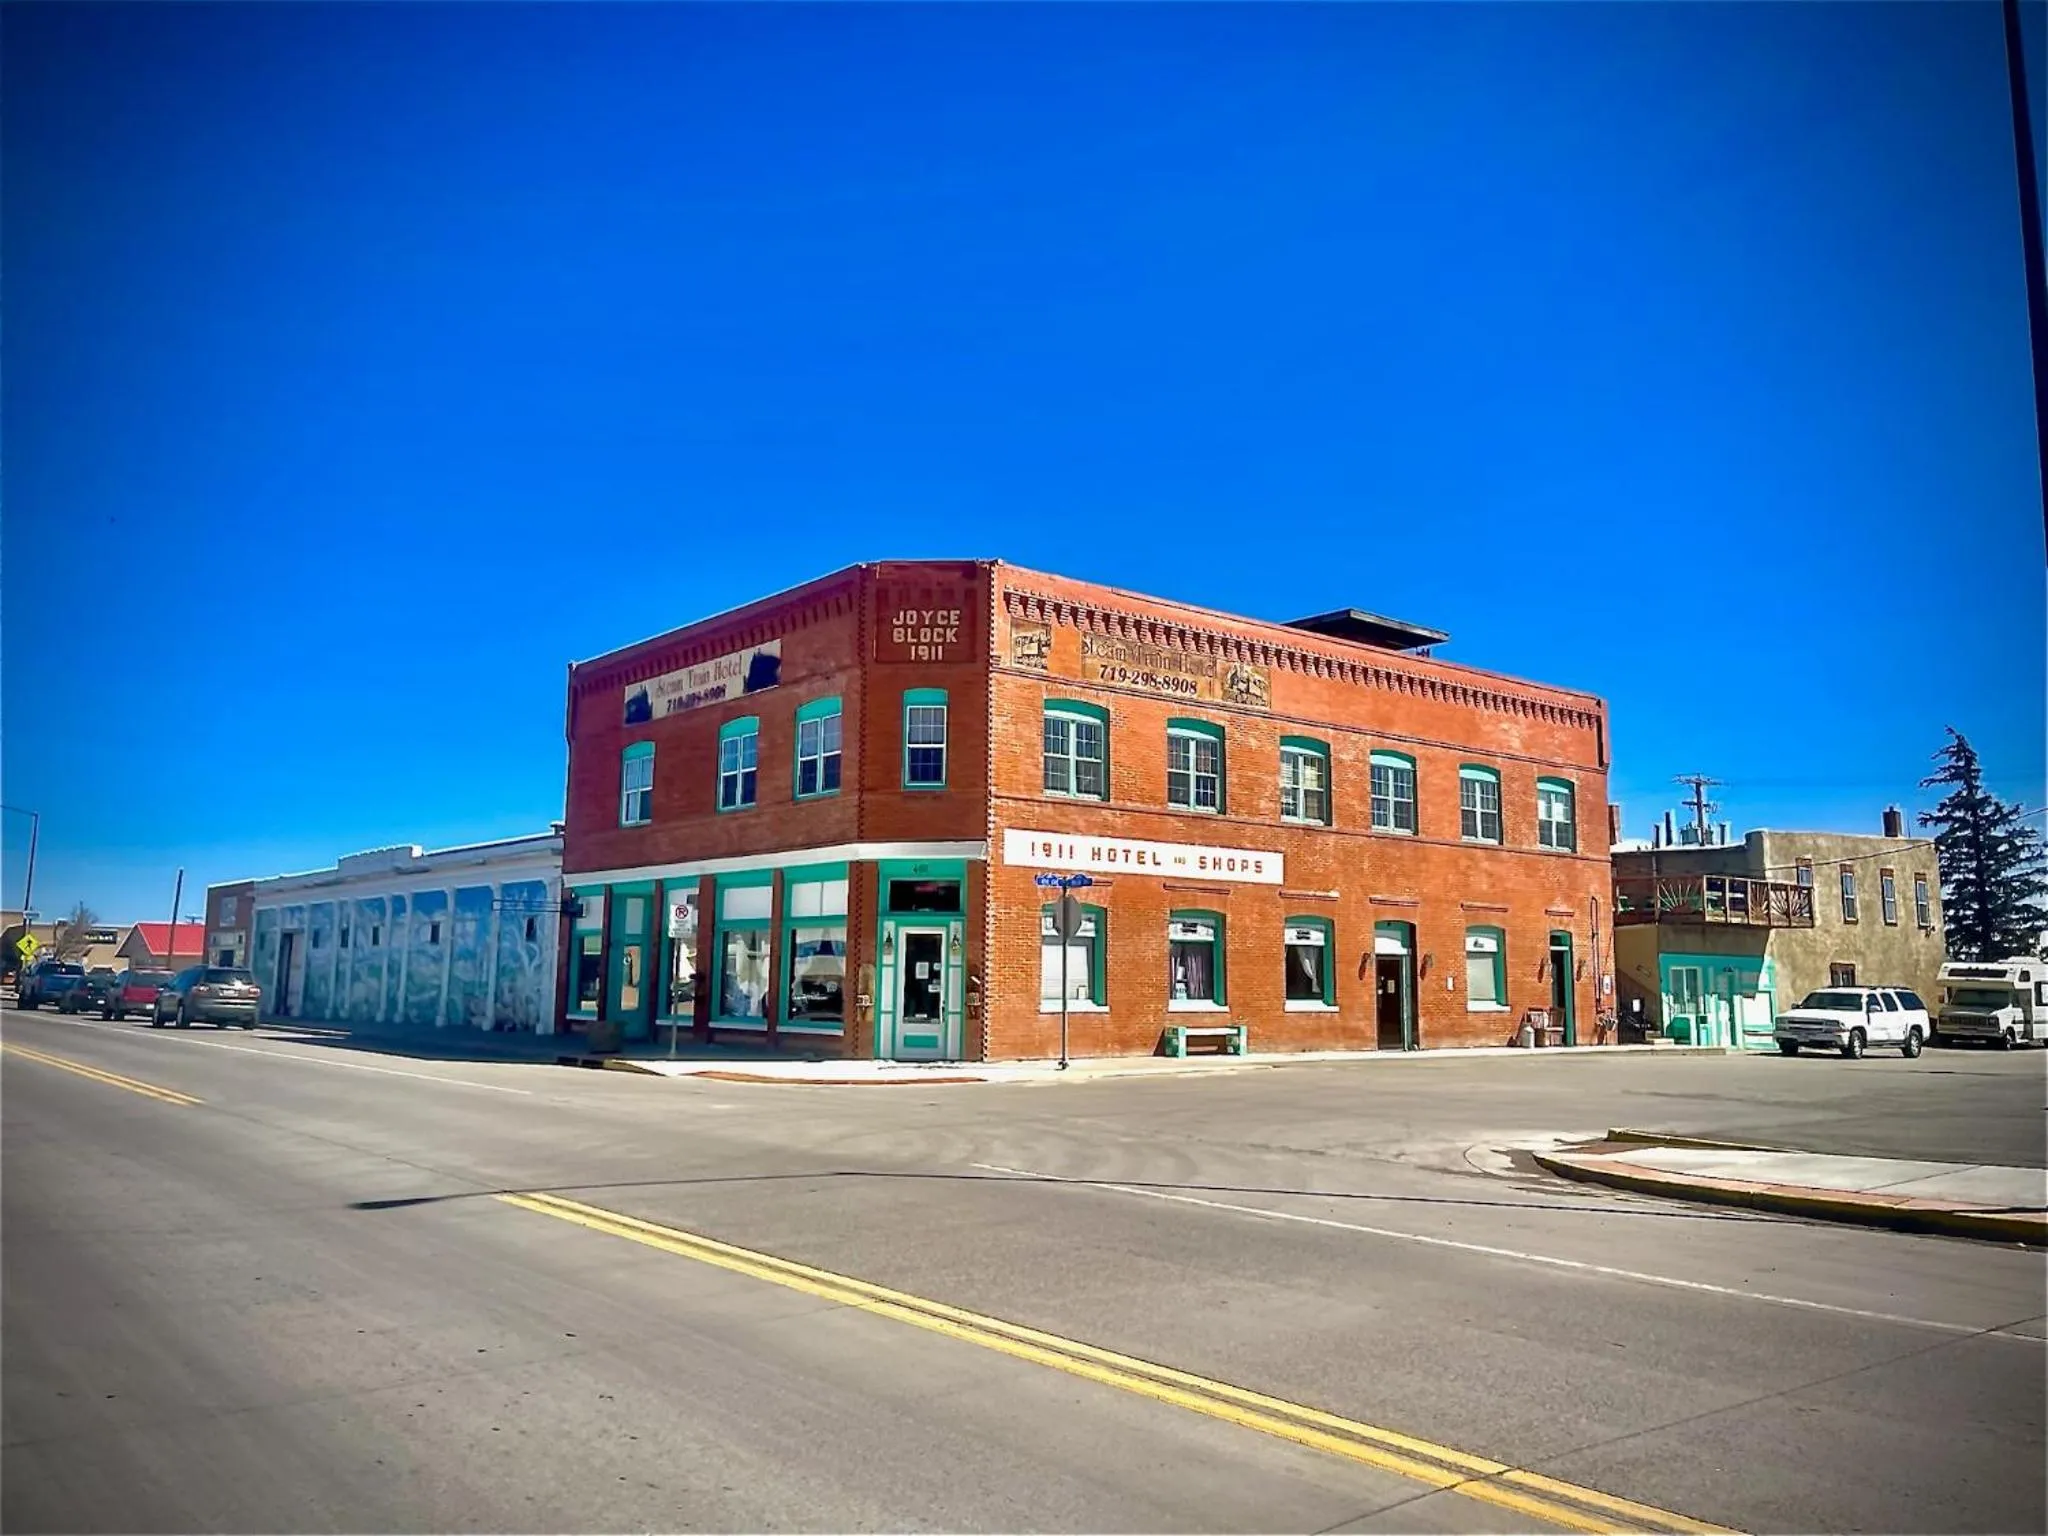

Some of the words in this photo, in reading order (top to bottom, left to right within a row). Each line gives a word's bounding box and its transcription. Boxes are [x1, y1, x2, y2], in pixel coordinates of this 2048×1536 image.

[893, 610, 960, 625] JOYCE
[893, 628, 958, 643] BLOCK
[911, 645, 943, 660] 1911
[714, 654, 742, 681] Hotel
[1099, 664, 1198, 695] 719-298-8908
[1031, 842, 1073, 859] 1911
[1092, 847, 1161, 866] HOTEL
[1199, 856, 1262, 873] SHOPS
